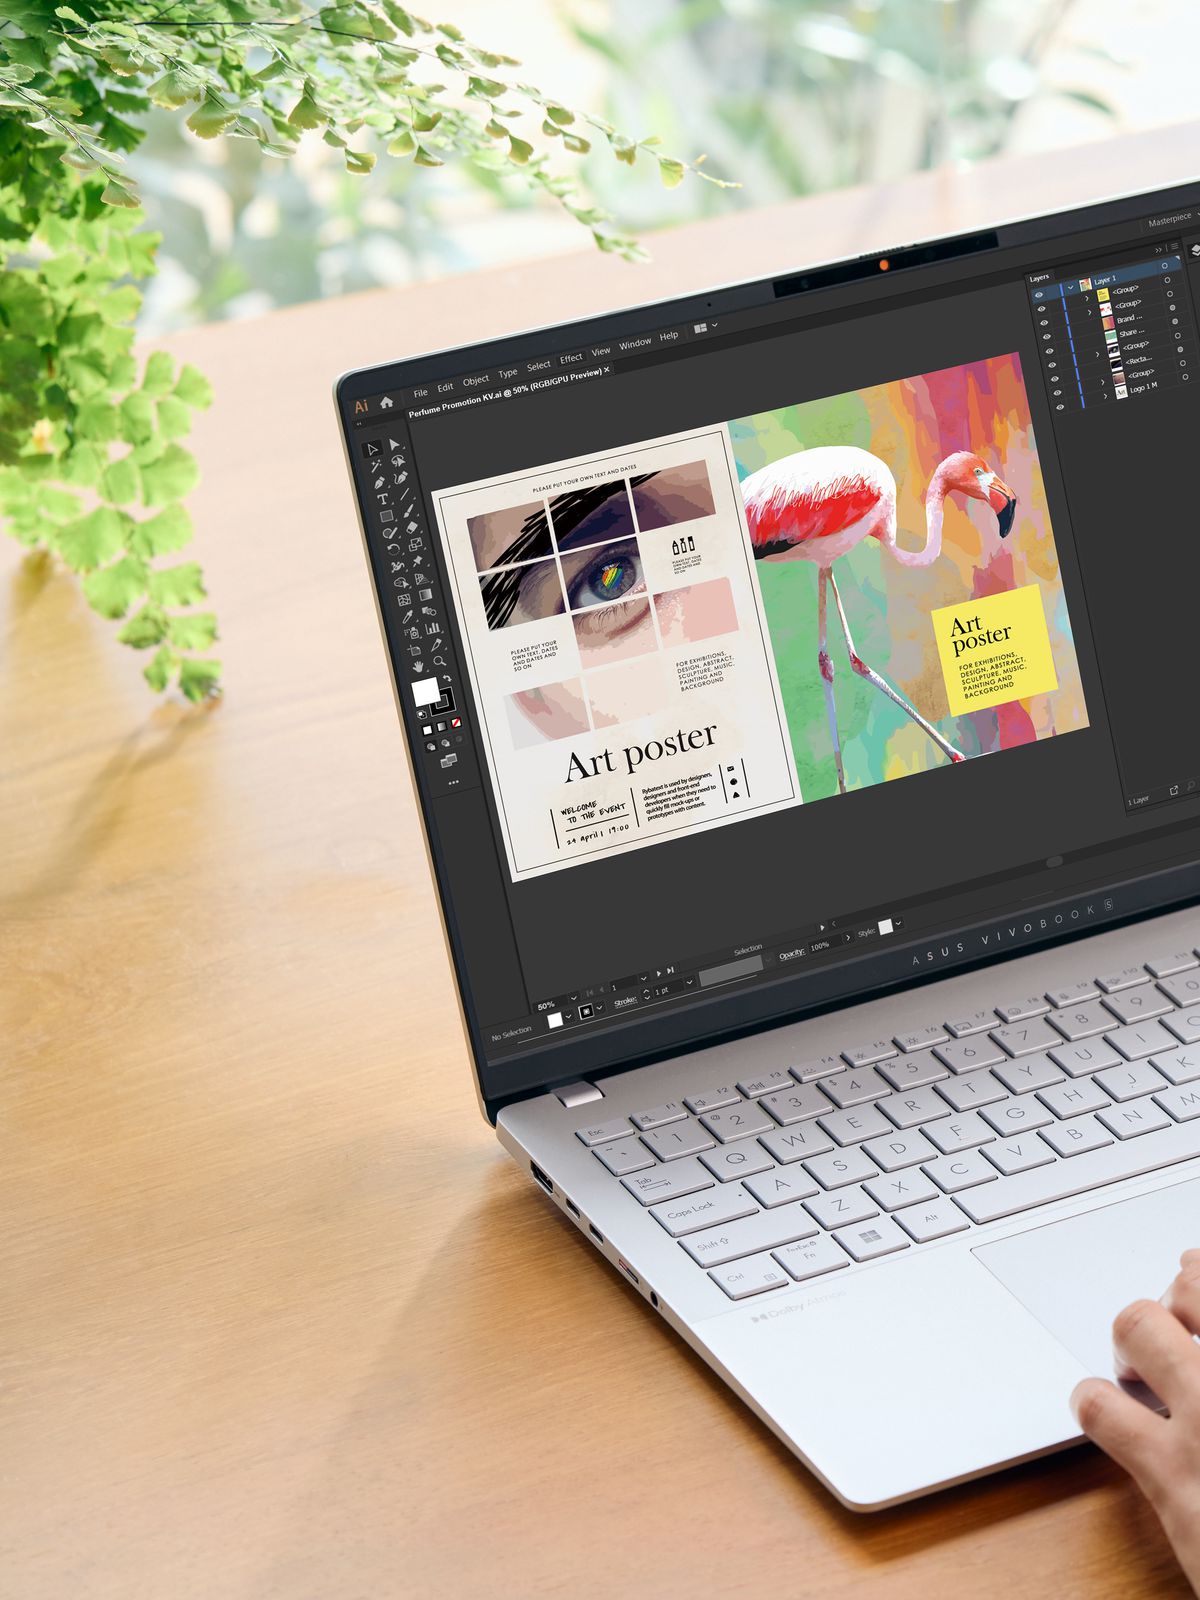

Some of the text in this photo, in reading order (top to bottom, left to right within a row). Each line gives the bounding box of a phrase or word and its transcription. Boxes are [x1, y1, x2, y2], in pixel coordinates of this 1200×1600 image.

[1148, 213, 1191, 227] Masterpiece
[1030, 274, 1049, 282] Layers
[1094, 277, 1110, 285] Layer
[1112, 285, 1139, 294] <Group>
[1115, 299, 1142, 309] <Group>
[1117, 314, 1135, 324] Brand
[1120, 330, 1137, 338] Share
[1123, 341, 1149, 350] <Group>
[414, 332, 678, 398] File Edit Object Type Select Effect View Window Help
[1128, 369, 1155, 378] <Group>
[409, 368, 602, 418] Perfume Promotion KV.ai @ 50% (RGB/GPU Preview)
[354, 400, 369, 414] Ai
[950, 616, 982, 637] Art
[952, 627, 1011, 657] poster
[511, 647, 530, 655] PLEASE
[541, 645, 558, 654] DATES
[526, 655, 543, 663] DATES
[959, 663, 973, 671] FOR
[680, 674, 708, 685] PAINTING
[681, 676, 724, 692] BACKGROUND
[963, 675, 1013, 692] PAINTING AND
[964, 682, 1014, 699] BACKGROUND
[565, 725, 716, 783] Art poster
[1133, 796, 1149, 804] Layer
[561, 801, 597, 815] WELCOME
[581, 810, 595, 820] THE
[599, 803, 626, 816] EVENT
[858, 928, 876, 938] Style:
[912, 943, 964, 966] ASUS
[982, 906, 1094, 945] VIVOBOOK
[734, 944, 762, 956] Selection
[811, 942, 829, 951] 100%
[779, 949, 805, 960] Opacity:
[538, 1001, 555, 1011] 50%
[614, 996, 637, 1008] Stroke:
[502, 1026, 532, 1038] Selection
[962, 1082, 976, 1093] T
[904, 1100, 920, 1112] R
[1006, 1107, 1025, 1118] G
[730, 1115, 744, 1126] 2
[846, 1116, 862, 1128] E
[588, 1129, 604, 1137] Esc
[1066, 1128, 1083, 1140] B
[781, 1132, 805, 1148] W
[889, 1143, 906, 1154] D
[726, 1152, 748, 1164] Q
[833, 1160, 848, 1172] S
[950, 1163, 969, 1174] C
[635, 1177, 652, 1185] Tab
[775, 1178, 791, 1191] A
[891, 1180, 909, 1193] X
[668, 1201, 714, 1219] Caps Lock
[831, 1199, 850, 1212] Z
[925, 1214, 938, 1222] Alt
[698, 1238, 719, 1252] Shift
[728, 1273, 744, 1282] Ctrl
